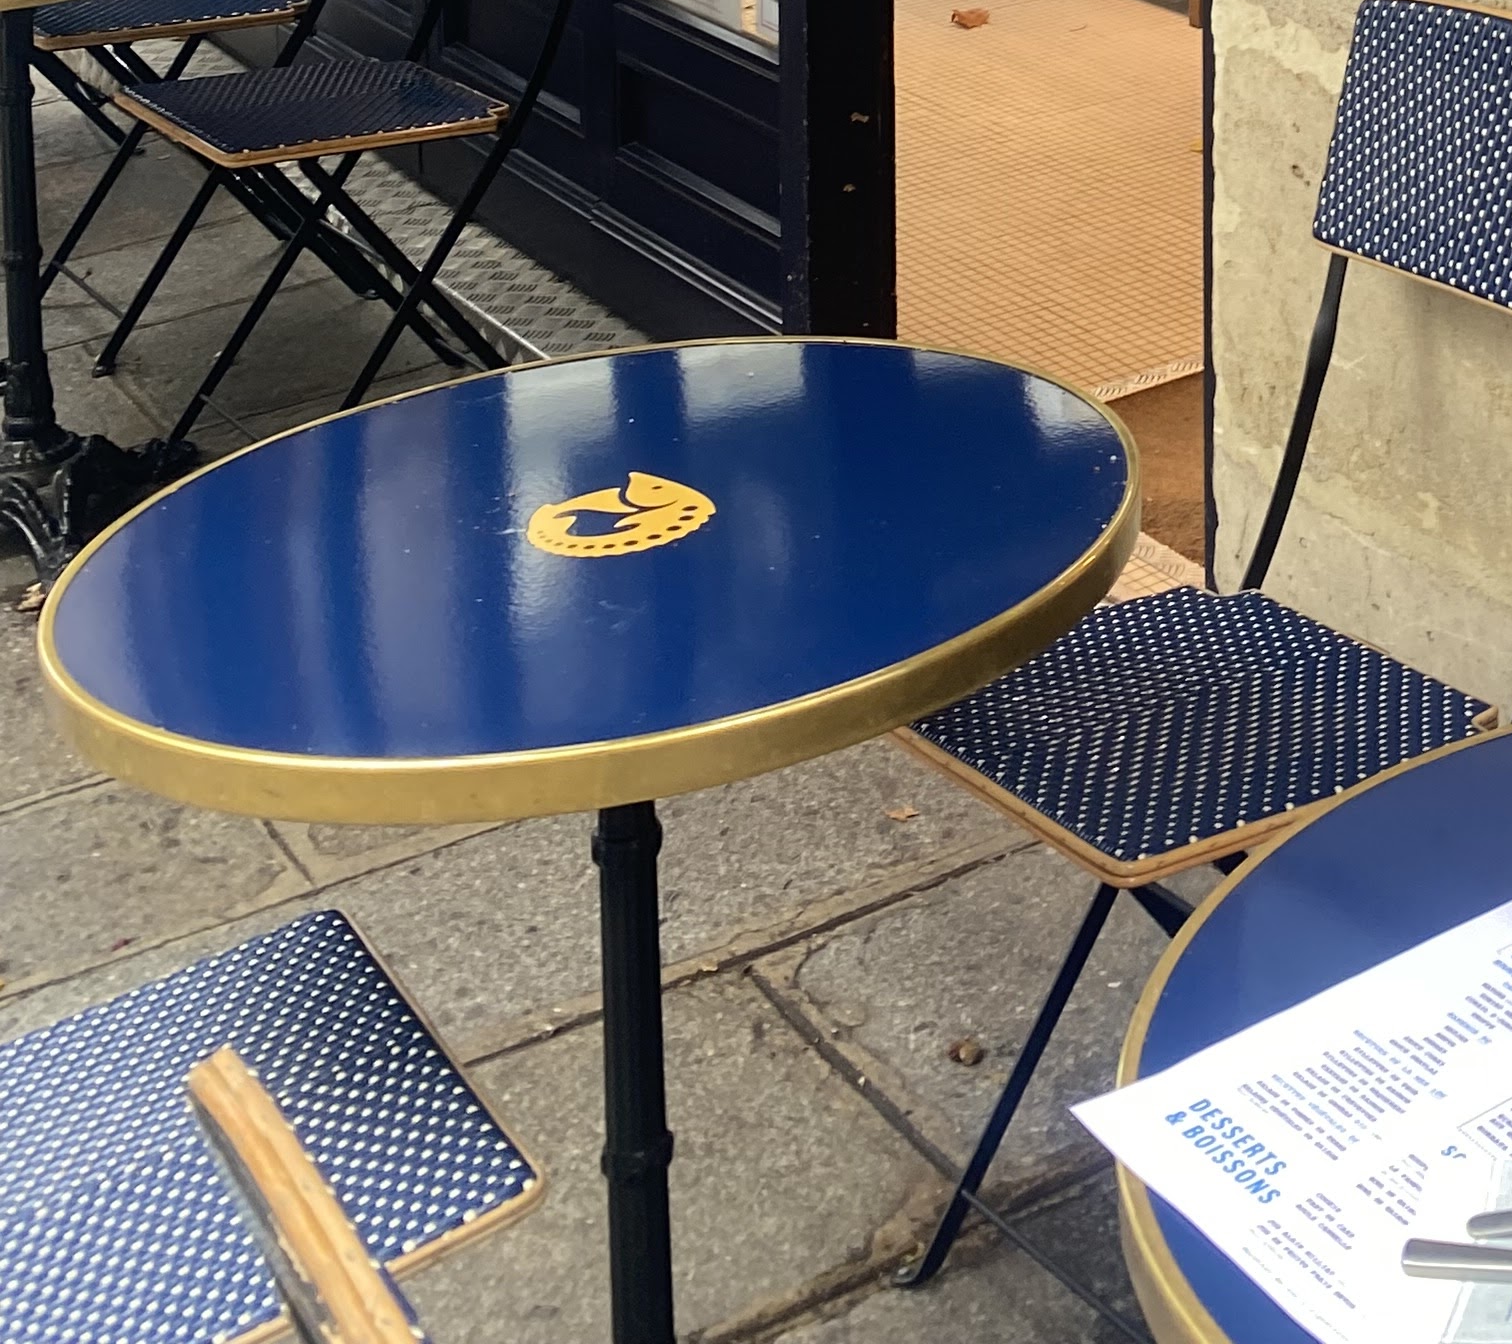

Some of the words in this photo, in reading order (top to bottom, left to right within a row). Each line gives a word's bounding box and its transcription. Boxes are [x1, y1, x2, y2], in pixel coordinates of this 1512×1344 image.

[1165, 1111, 1187, 1125] &
[1182, 1125, 1280, 1203] BOISSONS
[1189, 1099, 1286, 1175] DESSERTS
